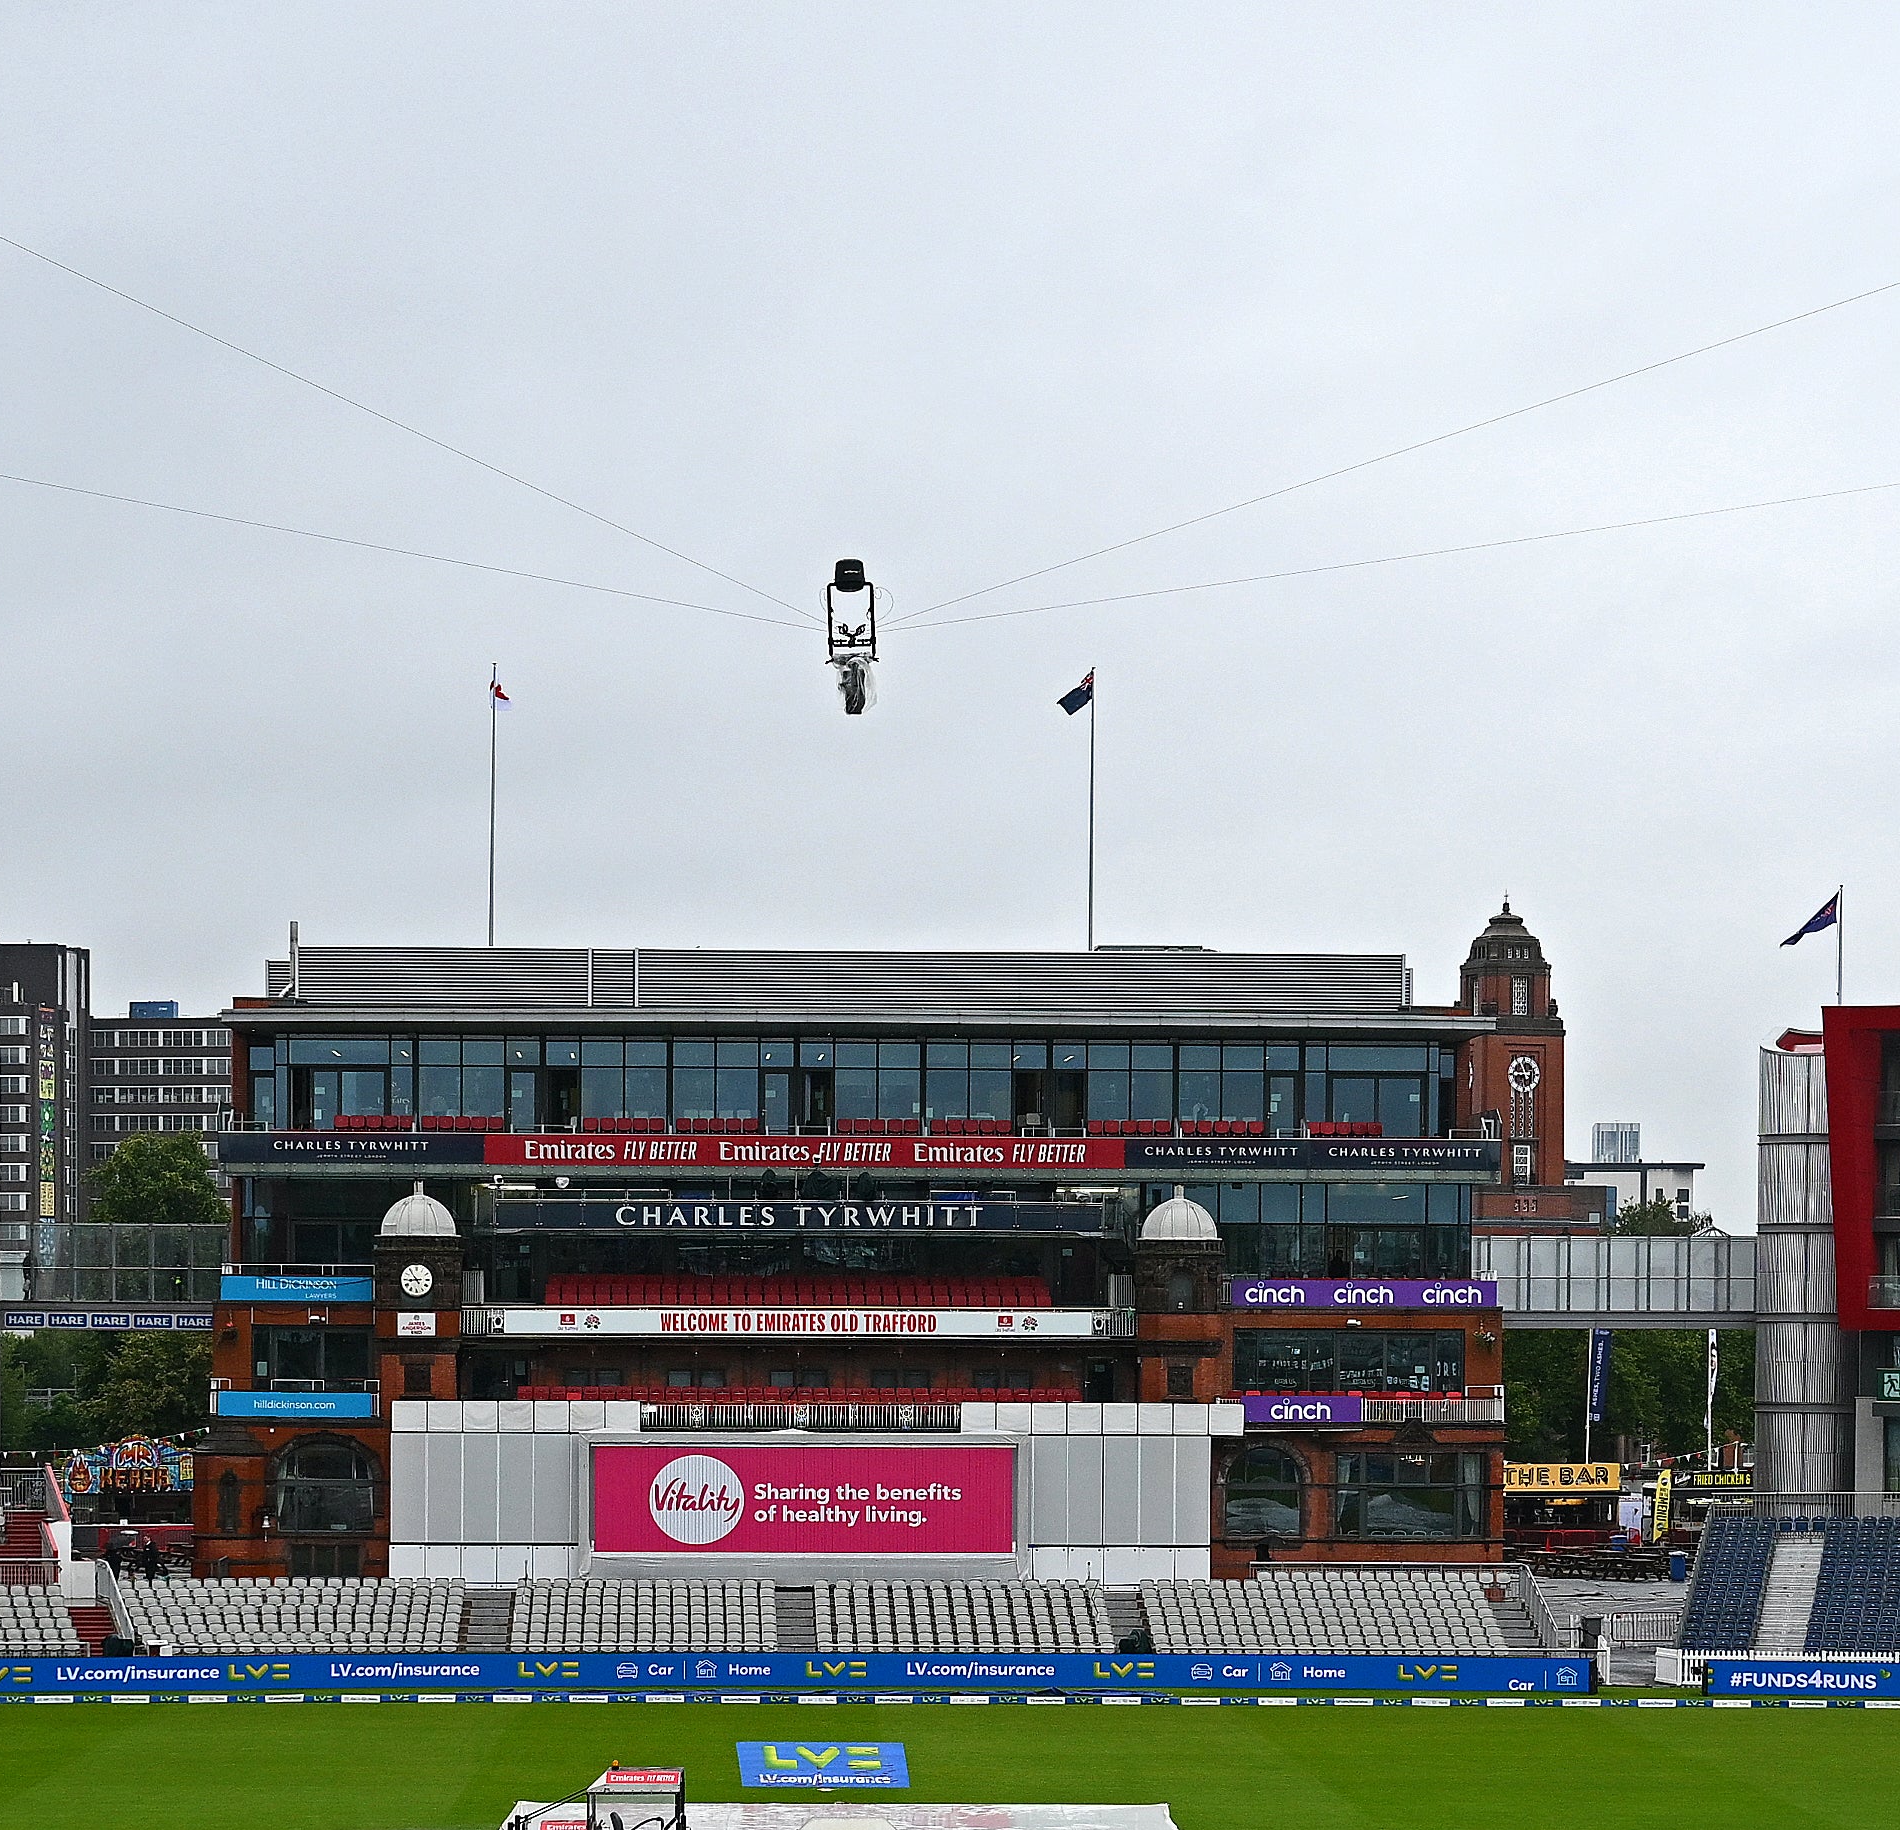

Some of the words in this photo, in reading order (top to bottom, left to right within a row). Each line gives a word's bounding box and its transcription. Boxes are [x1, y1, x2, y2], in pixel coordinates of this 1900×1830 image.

[273, 1140, 341, 1150] CHARLES
[348, 1141, 429, 1151] TYRWHITT
[525, 1140, 616, 1160] Emirates
[623, 1141, 649, 1160] FLY
[650, 1141, 698, 1161] BETTER
[719, 1142, 809, 1162] Emirates
[818, 1142, 843, 1162] FLY
[844, 1142, 892, 1163] BETTER
[914, 1142, 1004, 1163] Emirates
[1012, 1143, 1038, 1163] FLY
[1038, 1144, 1085, 1164] BETTER
[1145, 1146, 1211, 1157] CHARLES
[1218, 1146, 1298, 1157] TYRWHITT
[1329, 1147, 1396, 1158] CHARLES
[1402, 1147, 1482, 1158] TYRWHITT
[616, 1206, 776, 1227] CHARLES
[794, 1206, 983, 1227] TYRWHITT
[256, 1278, 278, 1290] HILL
[279, 1278, 337, 1290] DICKINSON
[1244, 1280, 1305, 1306] cinch
[1333, 1281, 1394, 1306] cinch
[1421, 1281, 1482, 1306] cinch
[8, 1316, 42, 1325] HARE
[51, 1316, 85, 1325] HARE
[94, 1316, 127, 1325] HARE
[136, 1317, 170, 1326] HARE
[179, 1317, 212, 1326] HARE
[660, 1313, 728, 1333] WELCOME
[733, 1313, 752, 1333] TO
[756, 1313, 826, 1333] EMIRATES
[831, 1313, 859, 1333] OLD
[863, 1313, 937, 1333] TRAFFORD
[254, 1400, 335, 1410] hilldickinson.com
[1270, 1398, 1331, 1420] cinch
[100, 1468, 169, 1488] KEBAB
[1559, 1467, 1610, 1485] BAR
[1693, 1474, 1713, 1486] FRIED
[1714, 1474, 1745, 1485] CHICKEN
[653, 1478, 742, 1523] Vitality
[754, 1483, 832, 1506] Sharing
[835, 1483, 871, 1501] the
[874, 1483, 962, 1501] benefits
[753, 1505, 777, 1523] of
[781, 1505, 859, 1527] healthy
[865, 1505, 928, 1527] living.
[57, 1665, 220, 1683] LV.com/insurance
[330, 1662, 480, 1679] LV.com/insurance
[647, 1663, 674, 1677] Car
[728, 1663, 771, 1677] Home
[906, 1662, 1056, 1679] LV.com/insurance
[1222, 1665, 1249, 1678] Car
[1303, 1666, 1347, 1678] Home
[1508, 1679, 1535, 1691] Car
[1730, 1669, 1877, 1690] #FUNDS4RUNS
[759, 1773, 891, 1786] LV.com/insurance
